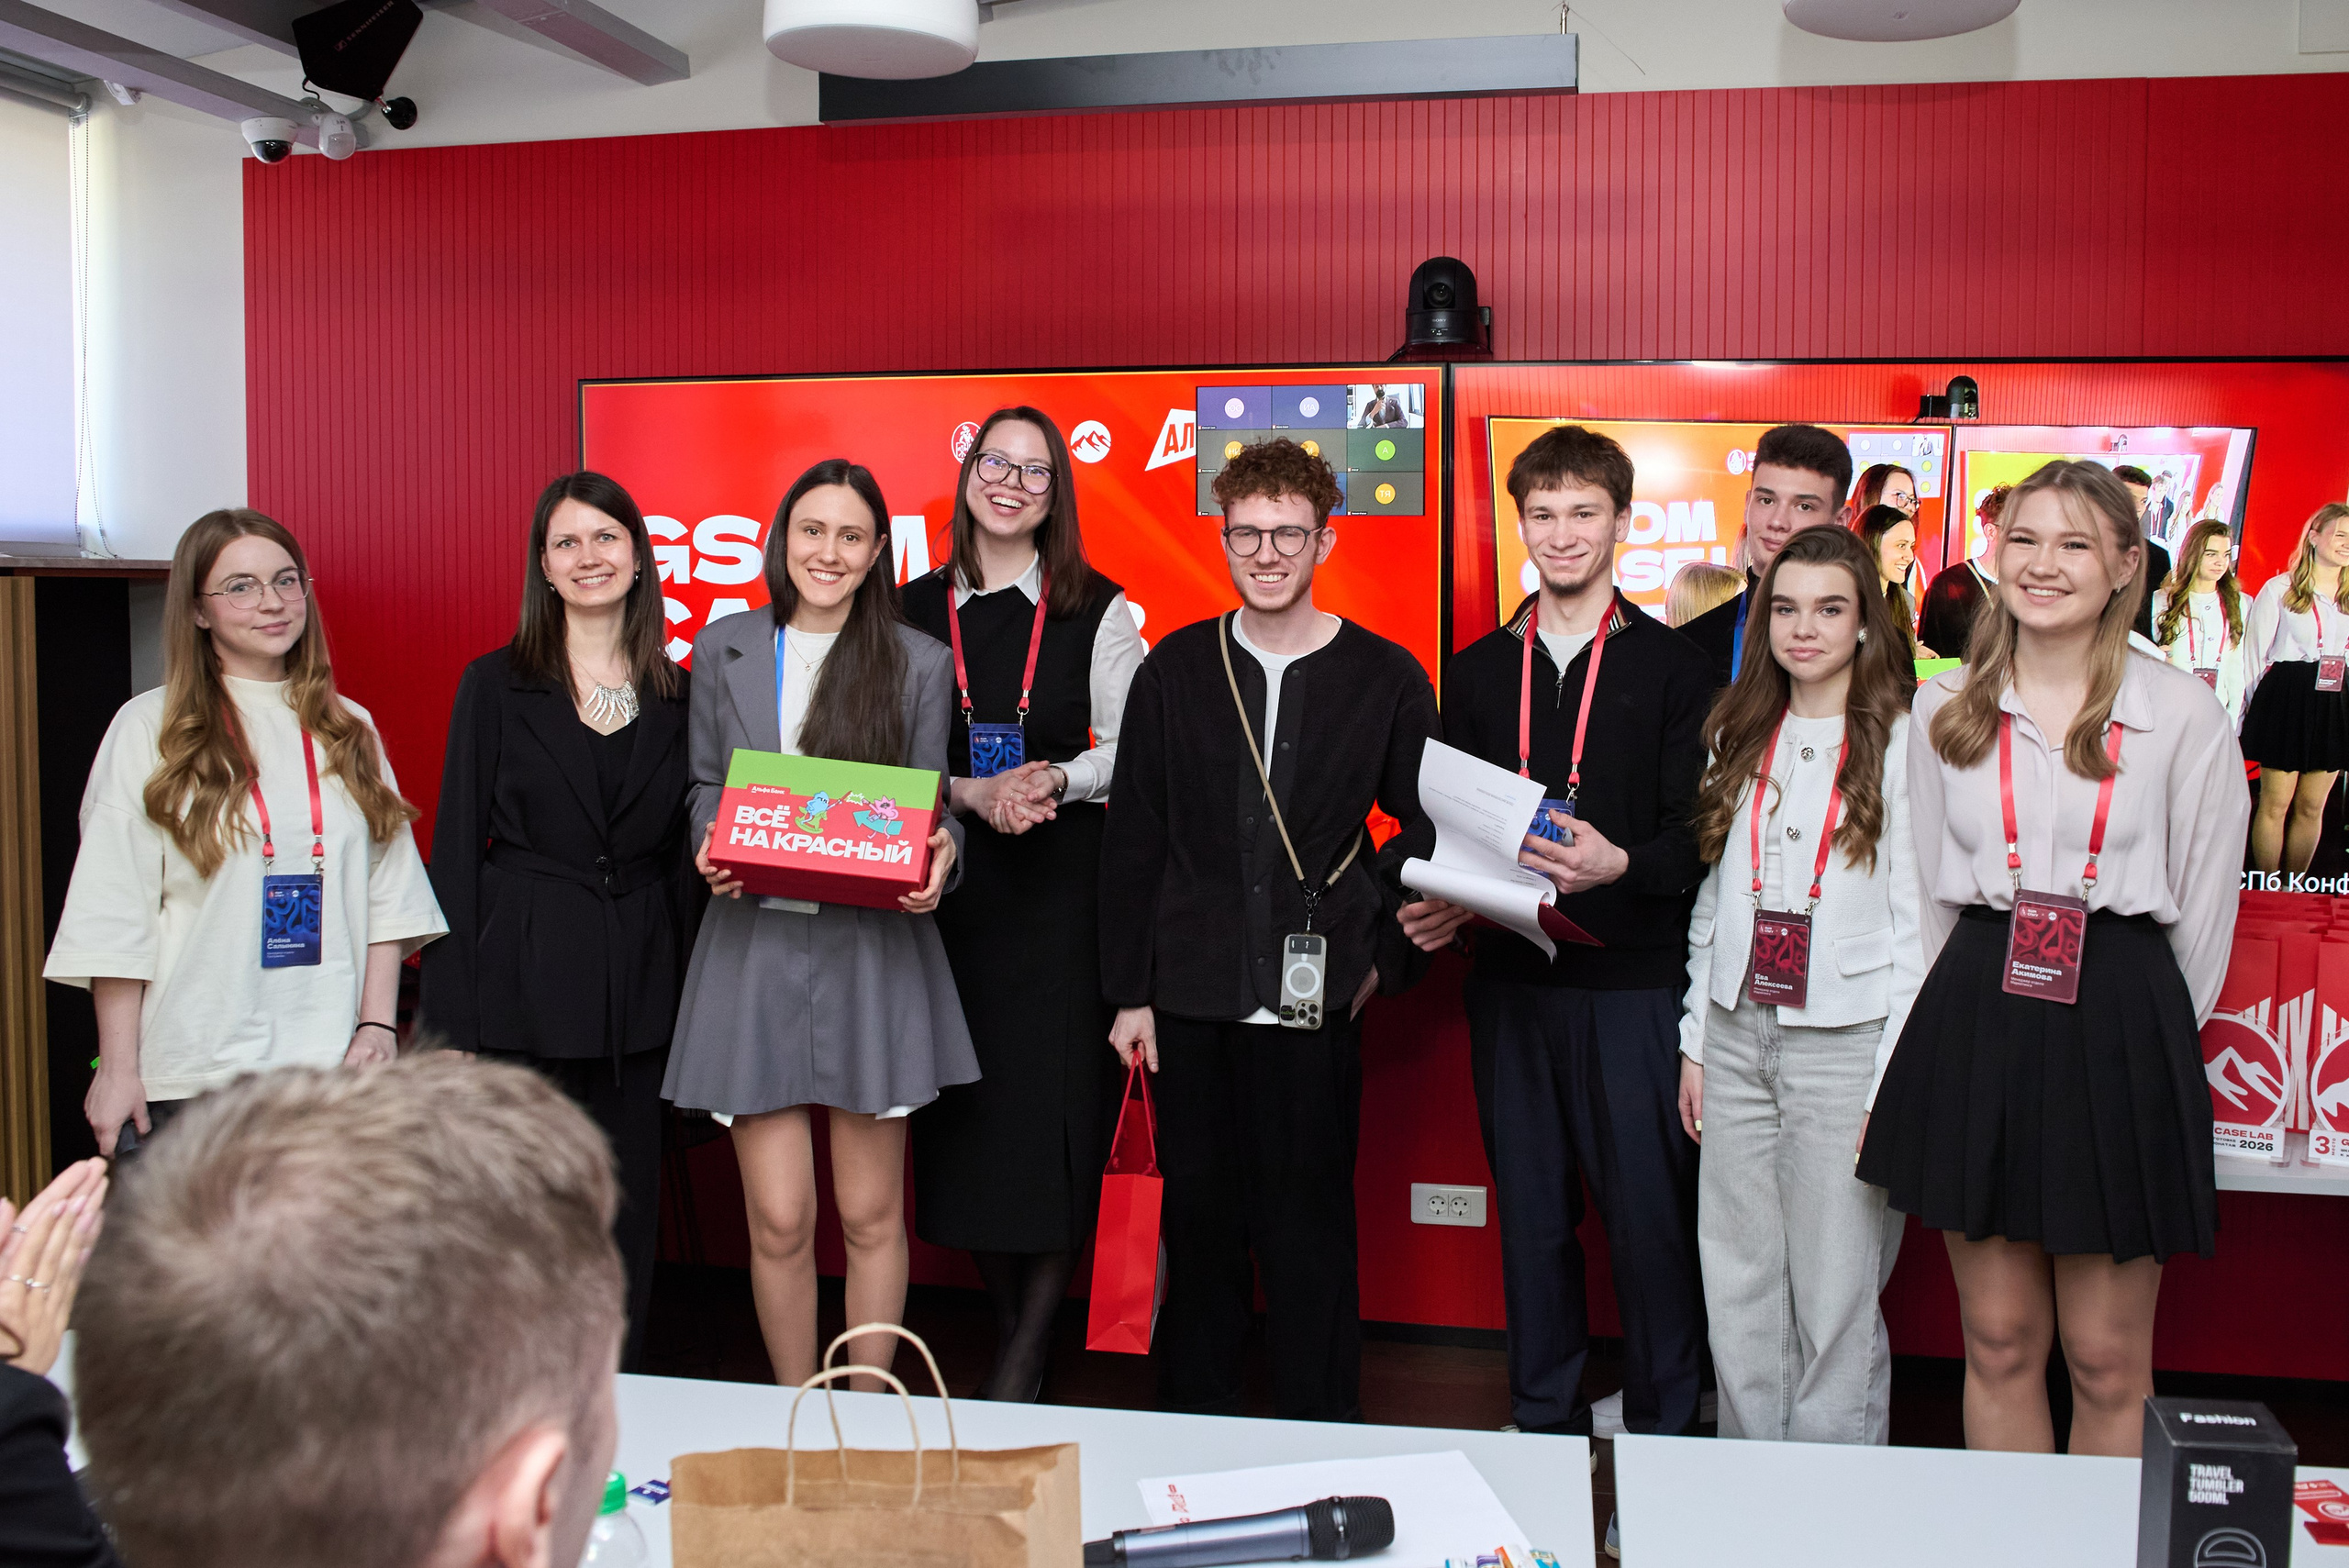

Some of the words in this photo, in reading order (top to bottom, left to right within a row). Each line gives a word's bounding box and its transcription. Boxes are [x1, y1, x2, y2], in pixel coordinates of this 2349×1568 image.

[346, 0, 395, 41] SENNHEISER
[1379, 489, 1391, 498] ТЯ
[644, 514, 930, 585] GSM
[751, 785, 770, 794] Альфа
[734, 805, 791, 829] ВСЁ
[729, 827, 770, 850] НА
[772, 831, 913, 865] КРАСНЫЙ
[2010, 968, 2053, 982] Акимова
[2012, 961, 2063, 976] Екатерина
[1753, 979, 1793, 990] Алексеева
[2214, 1127, 2248, 1138] CASE
[2249, 1131, 2274, 1140] LAB
[2239, 1140, 2274, 1151] 2026
[2314, 1135, 2330, 1154] 3
[2179, 1412, 2257, 1427] Fashion
[2189, 1463, 2234, 1480] TRAVEL
[2188, 1478, 2244, 1494] TUMBLER
